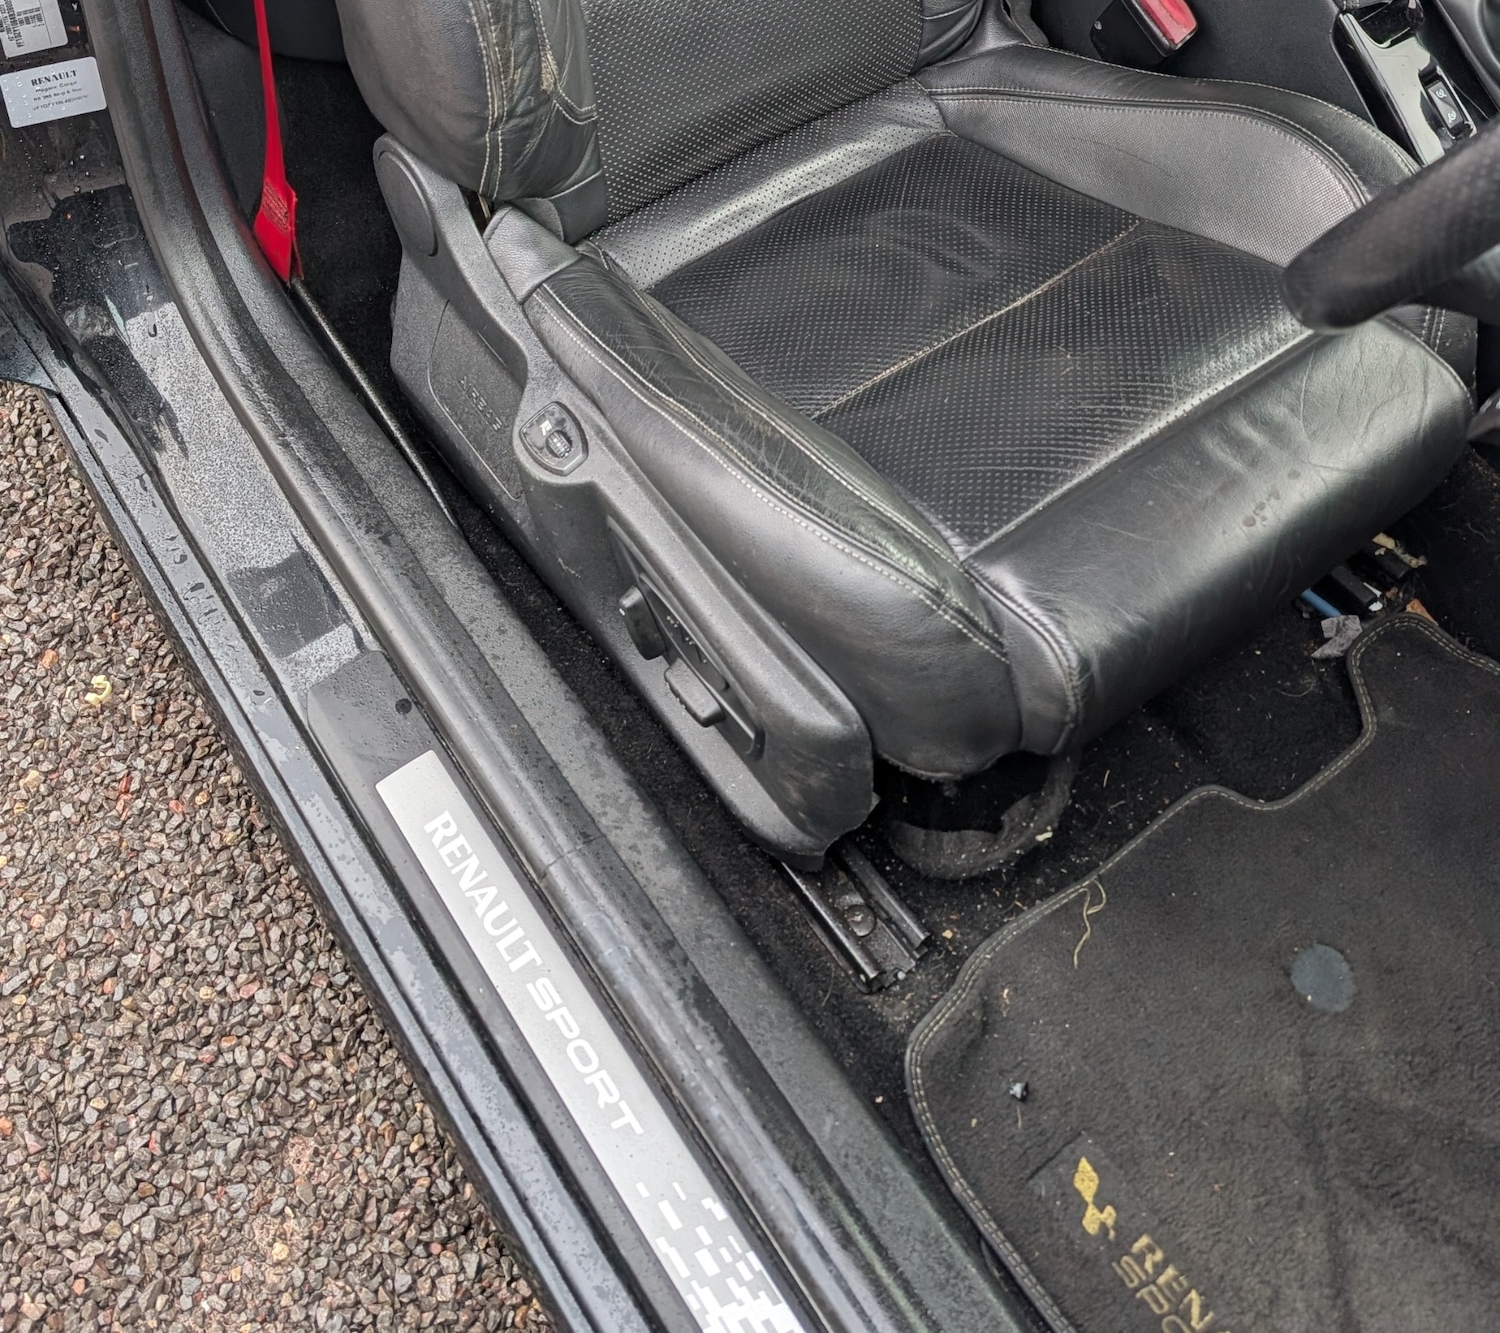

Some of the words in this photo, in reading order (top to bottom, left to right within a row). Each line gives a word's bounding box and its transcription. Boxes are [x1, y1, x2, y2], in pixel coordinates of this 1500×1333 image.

[31, 70, 78, 87] RENAULT
[424, 810, 543, 975] RENAULT
[526, 976, 644, 1137] SPORT
[1131, 1233, 1222, 1333] REN
